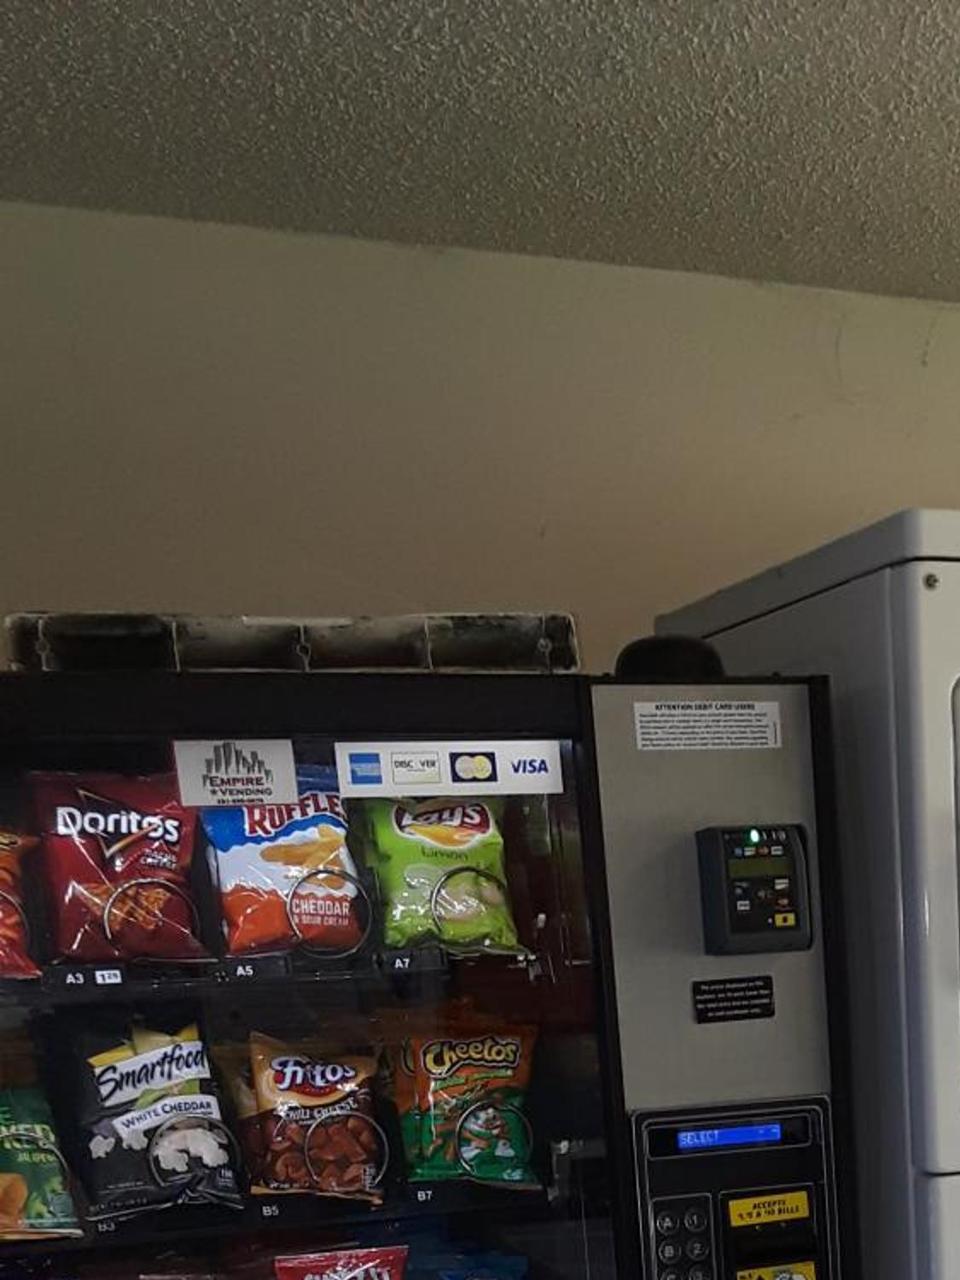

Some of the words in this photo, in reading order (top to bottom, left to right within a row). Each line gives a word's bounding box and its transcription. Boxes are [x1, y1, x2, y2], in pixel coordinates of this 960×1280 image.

[394, 760, 435, 768] DISCVER
[511, 759, 548, 774] VISA
[209, 776, 264, 787] EMPIRE
[56, 806, 181, 844] Doritos
[292, 899, 350, 916] CHEDDAR
[236, 966, 253, 976] A5
[394, 958, 410, 968] A7
[66, 974, 84, 984] A3
[424, 1039, 517, 1075] Cheetos
[96, 1044, 207, 1099] Smartfood
[271, 1056, 355, 1090] Fritos
[120, 1108, 160, 1129] WHITE
[161, 1100, 213, 1115] CHEDDAR
